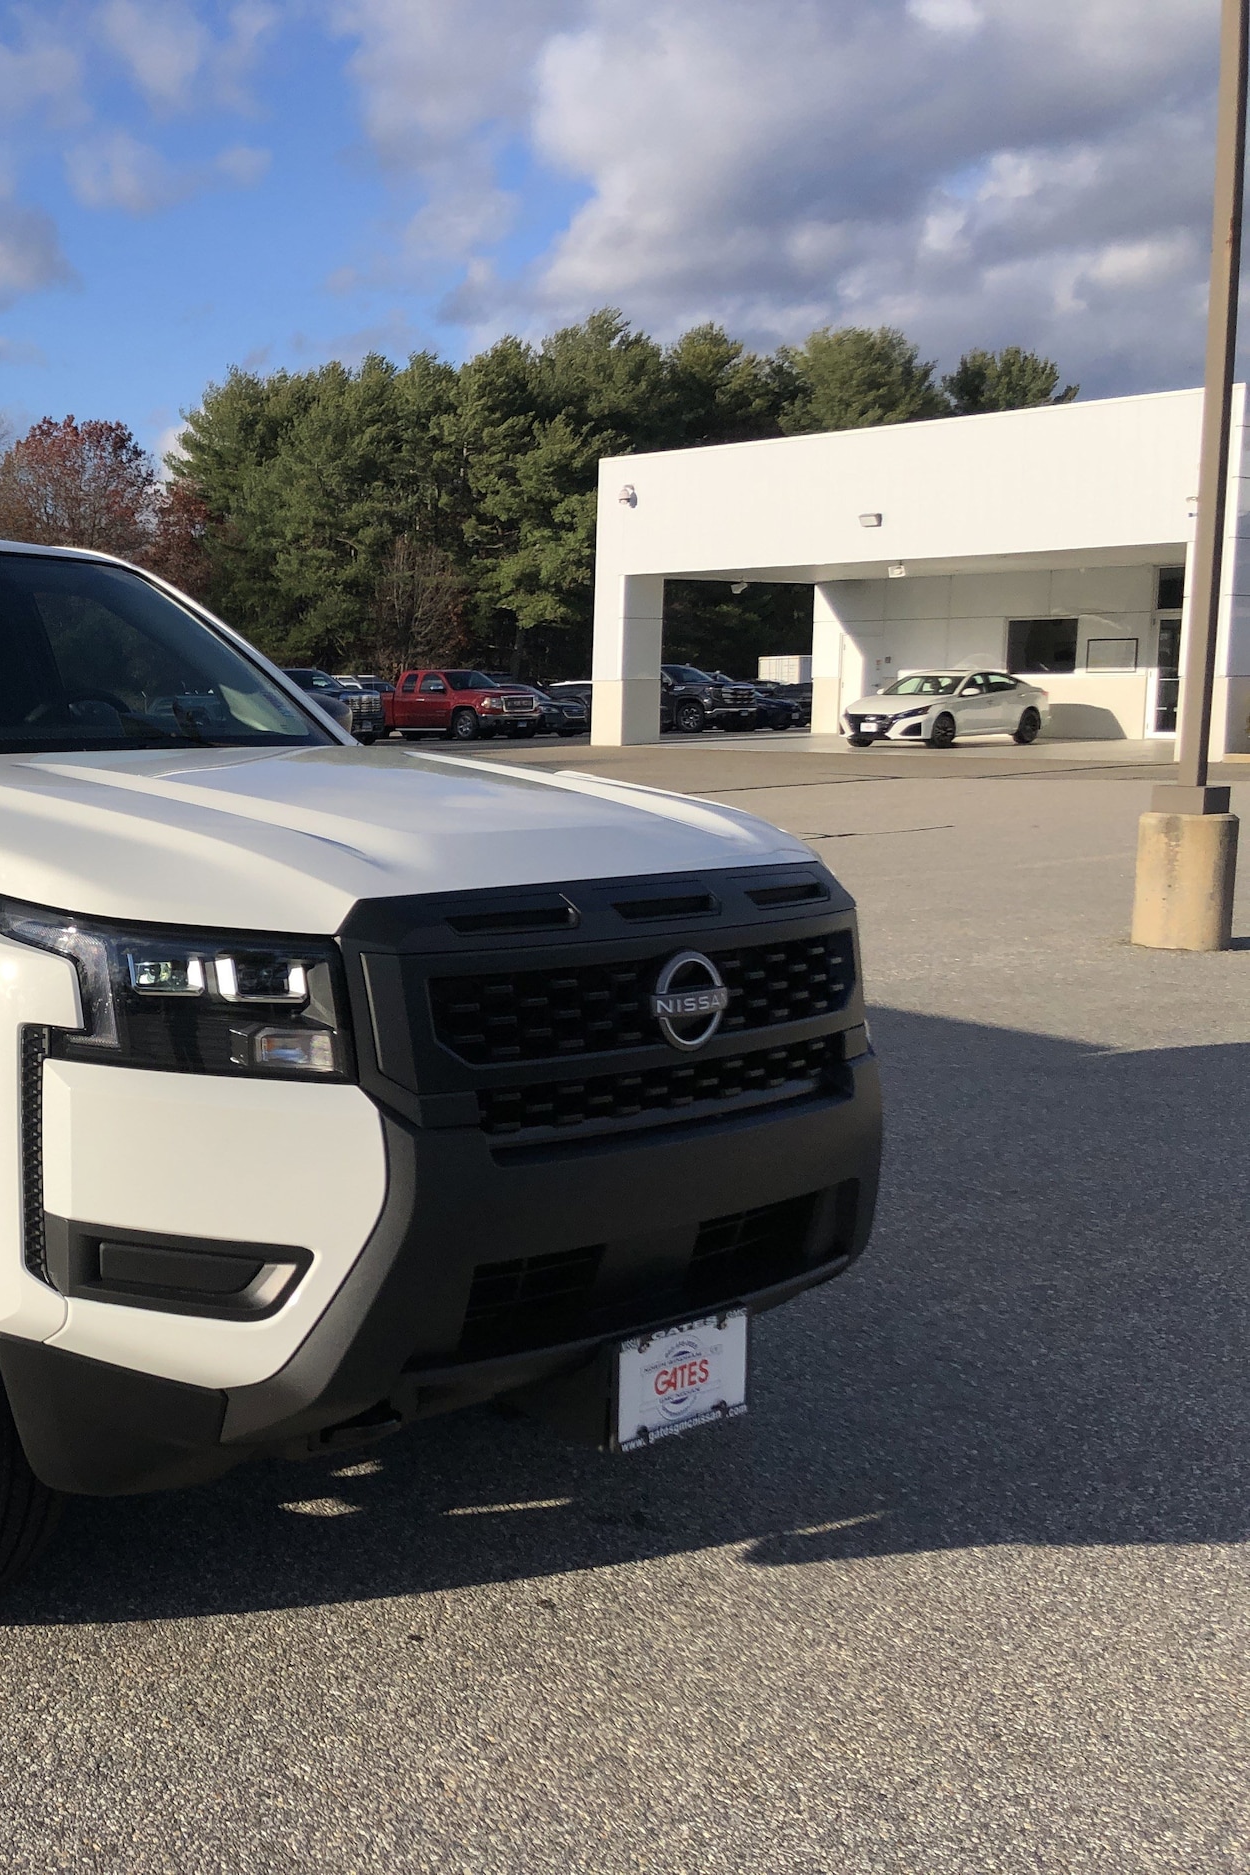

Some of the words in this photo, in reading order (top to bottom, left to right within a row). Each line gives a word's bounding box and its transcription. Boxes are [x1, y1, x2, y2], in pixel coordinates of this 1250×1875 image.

[656, 993, 726, 1013] NISSAN
[651, 1316, 717, 1340] GATES
[654, 1359, 709, 1395] GATES
